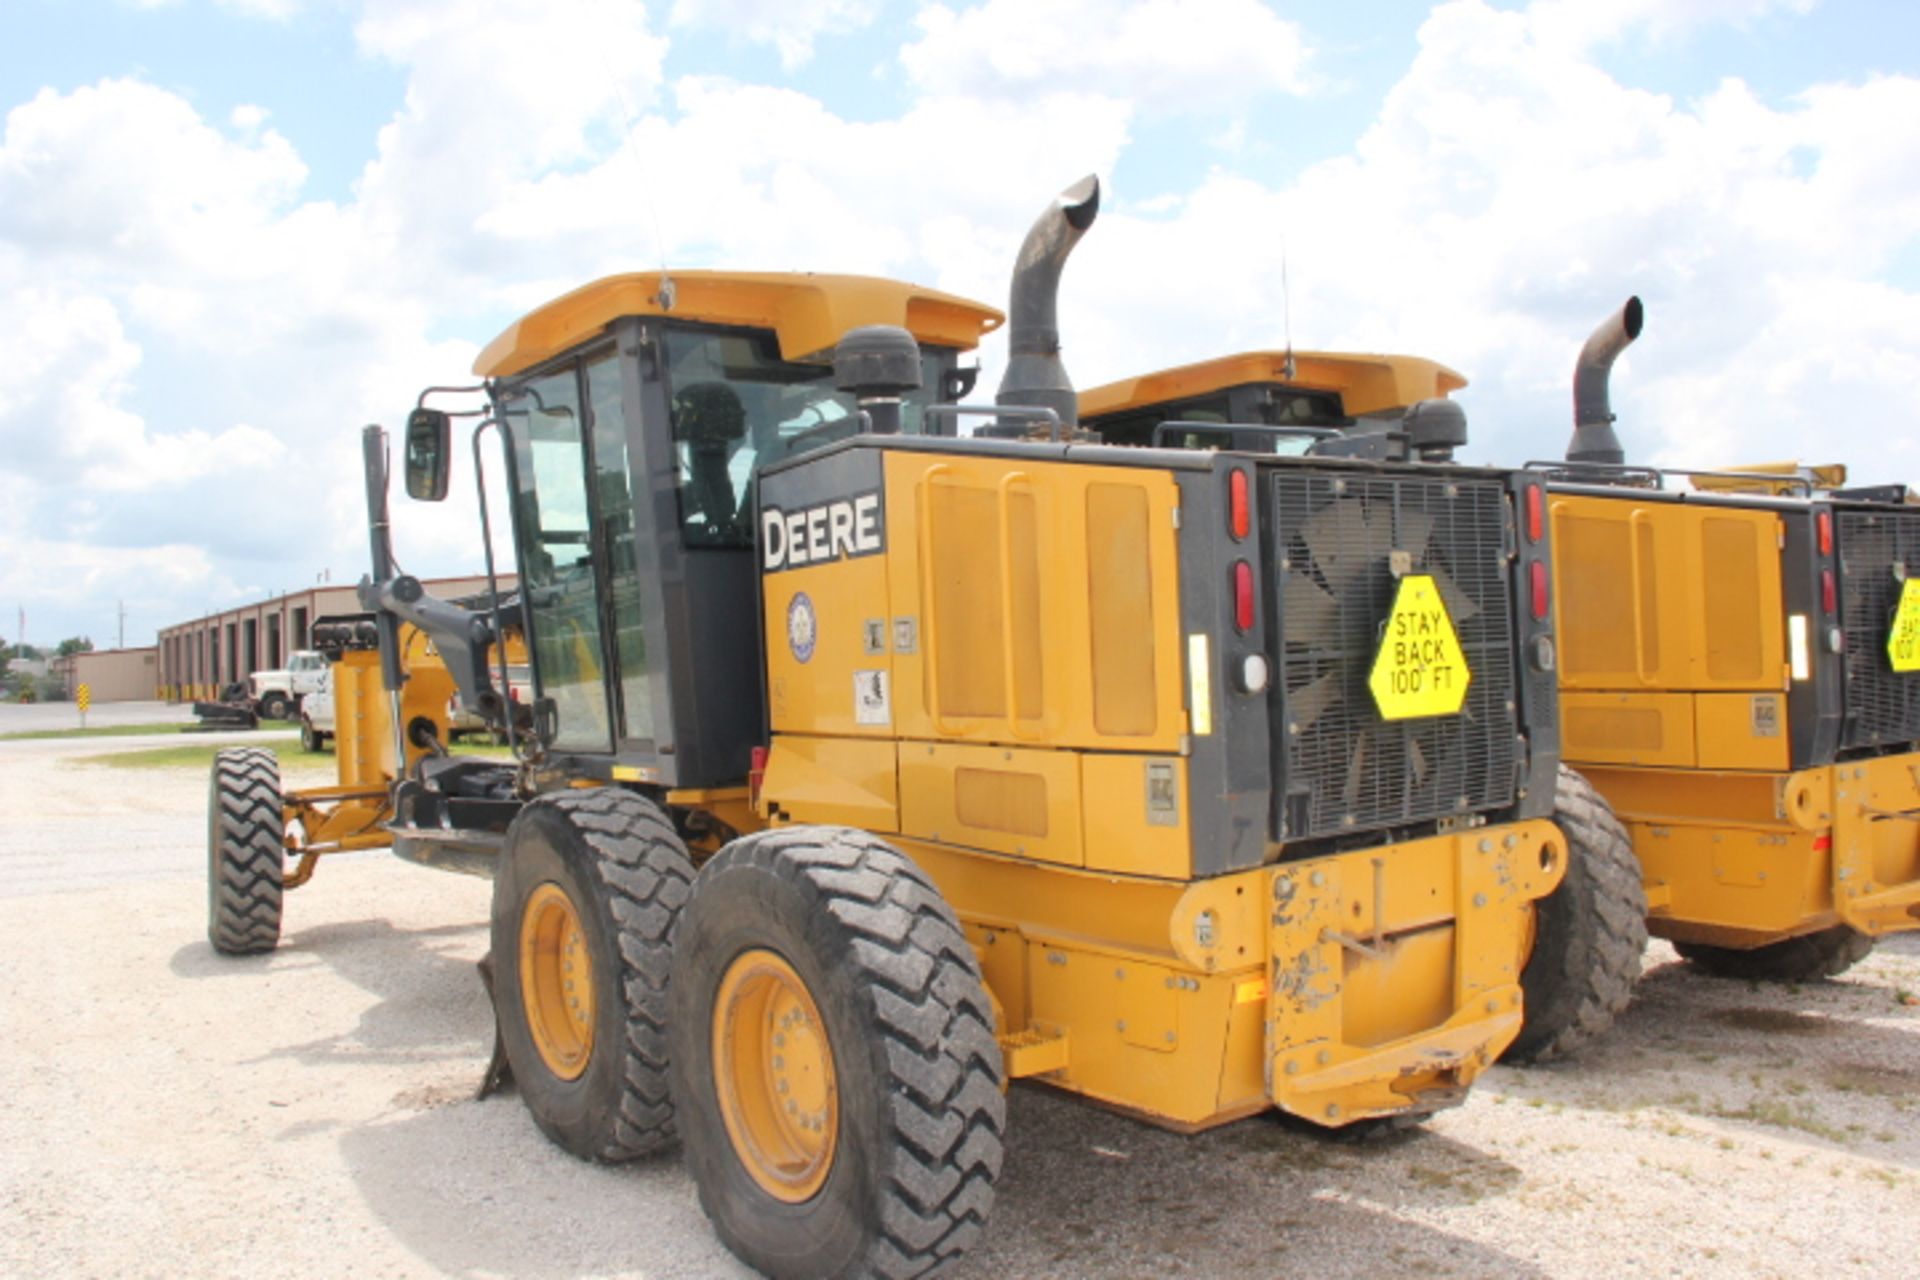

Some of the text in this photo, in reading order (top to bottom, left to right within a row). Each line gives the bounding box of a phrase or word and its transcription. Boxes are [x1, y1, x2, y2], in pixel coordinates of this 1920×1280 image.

[762, 495, 880, 570] DEERE
[1396, 612, 1441, 637] STAY
[1395, 640, 1445, 665] BACK
[1390, 666, 1454, 695] 100 FT
